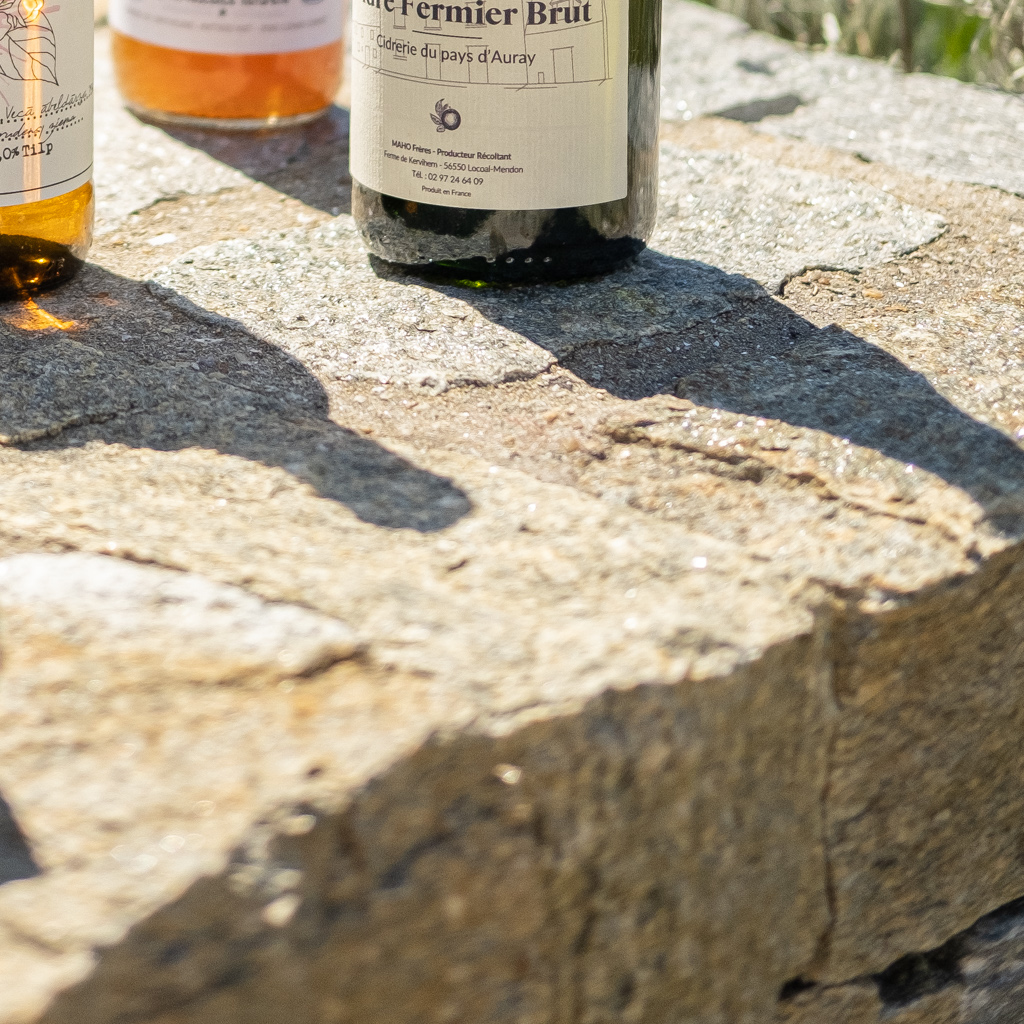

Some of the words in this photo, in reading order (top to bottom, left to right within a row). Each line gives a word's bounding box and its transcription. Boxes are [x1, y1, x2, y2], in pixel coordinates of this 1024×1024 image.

[527, 0, 592, 26] Brut
[376, 34, 417, 56] Cidrerie
[421, 43, 437, 59] du
[441, 49, 473, 66] pays
[478, 49, 536, 67] d'Auray
[21, 142, 54, 157] Tilp
[391, 139, 411, 151] MAHO
[412, 144, 432, 154] Frères
[437, 148, 475, 159] Producteur
[477, 152, 512, 161] Récoltant
[400, 155, 408, 163] de
[443, 162, 466, 171] 56550
[467, 164, 524, 174] Locoal-Mendon
[428, 173, 437, 181] 02
[439, 174, 449, 182] 97
[450, 175, 460, 184] 24
[462, 176, 472, 184] 64
[473, 177, 484, 186] 09
[421, 185, 442, 194] Produit
[451, 189, 472, 197] France
